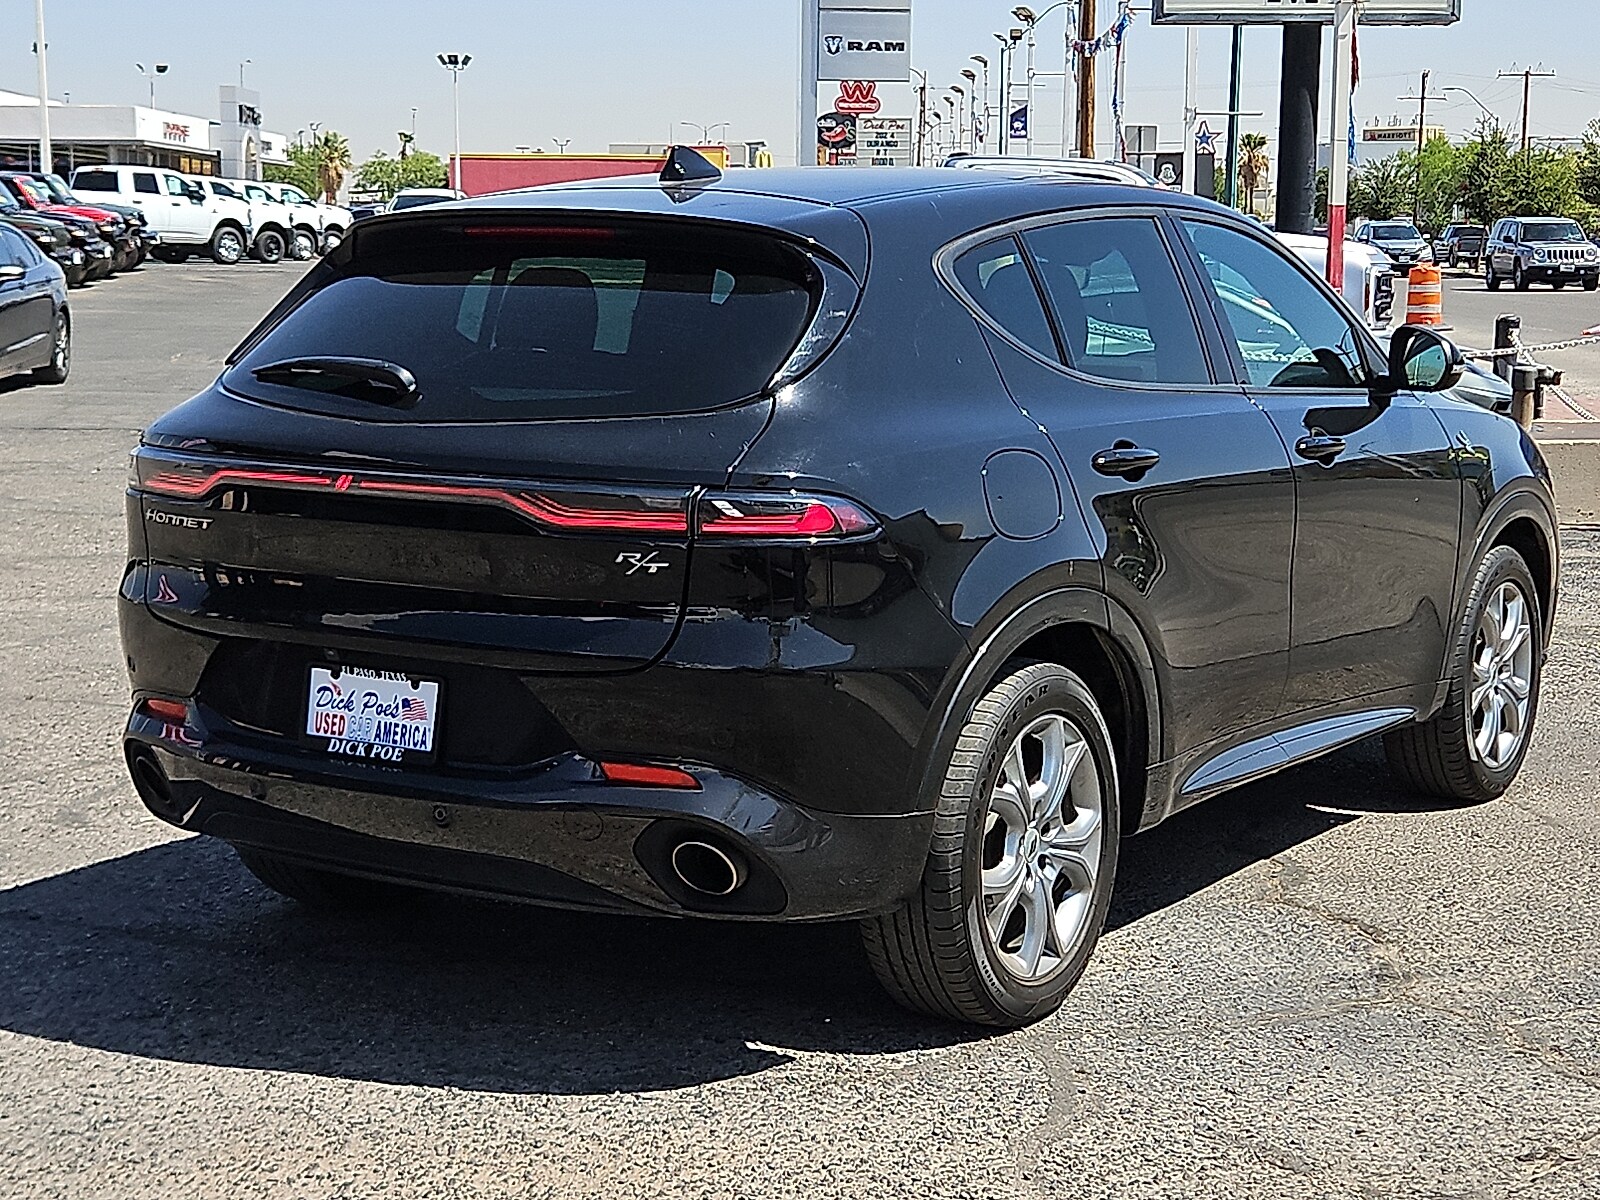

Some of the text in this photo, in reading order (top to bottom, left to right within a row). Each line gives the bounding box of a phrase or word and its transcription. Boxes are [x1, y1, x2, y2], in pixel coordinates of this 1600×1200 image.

[847, 40, 905, 52] RAM
[863, 119, 905, 130] Dick Poe
[146, 509, 214, 530] HORNET
[615, 551, 669, 575] R/T
[341, 665, 351, 676] EL
[380, 671, 407, 682] TEXAS
[316, 685, 399, 719] Dick Poe's
[314, 711, 428, 750] USED CAR AMERICA
[327, 738, 405, 762] DICK POE
